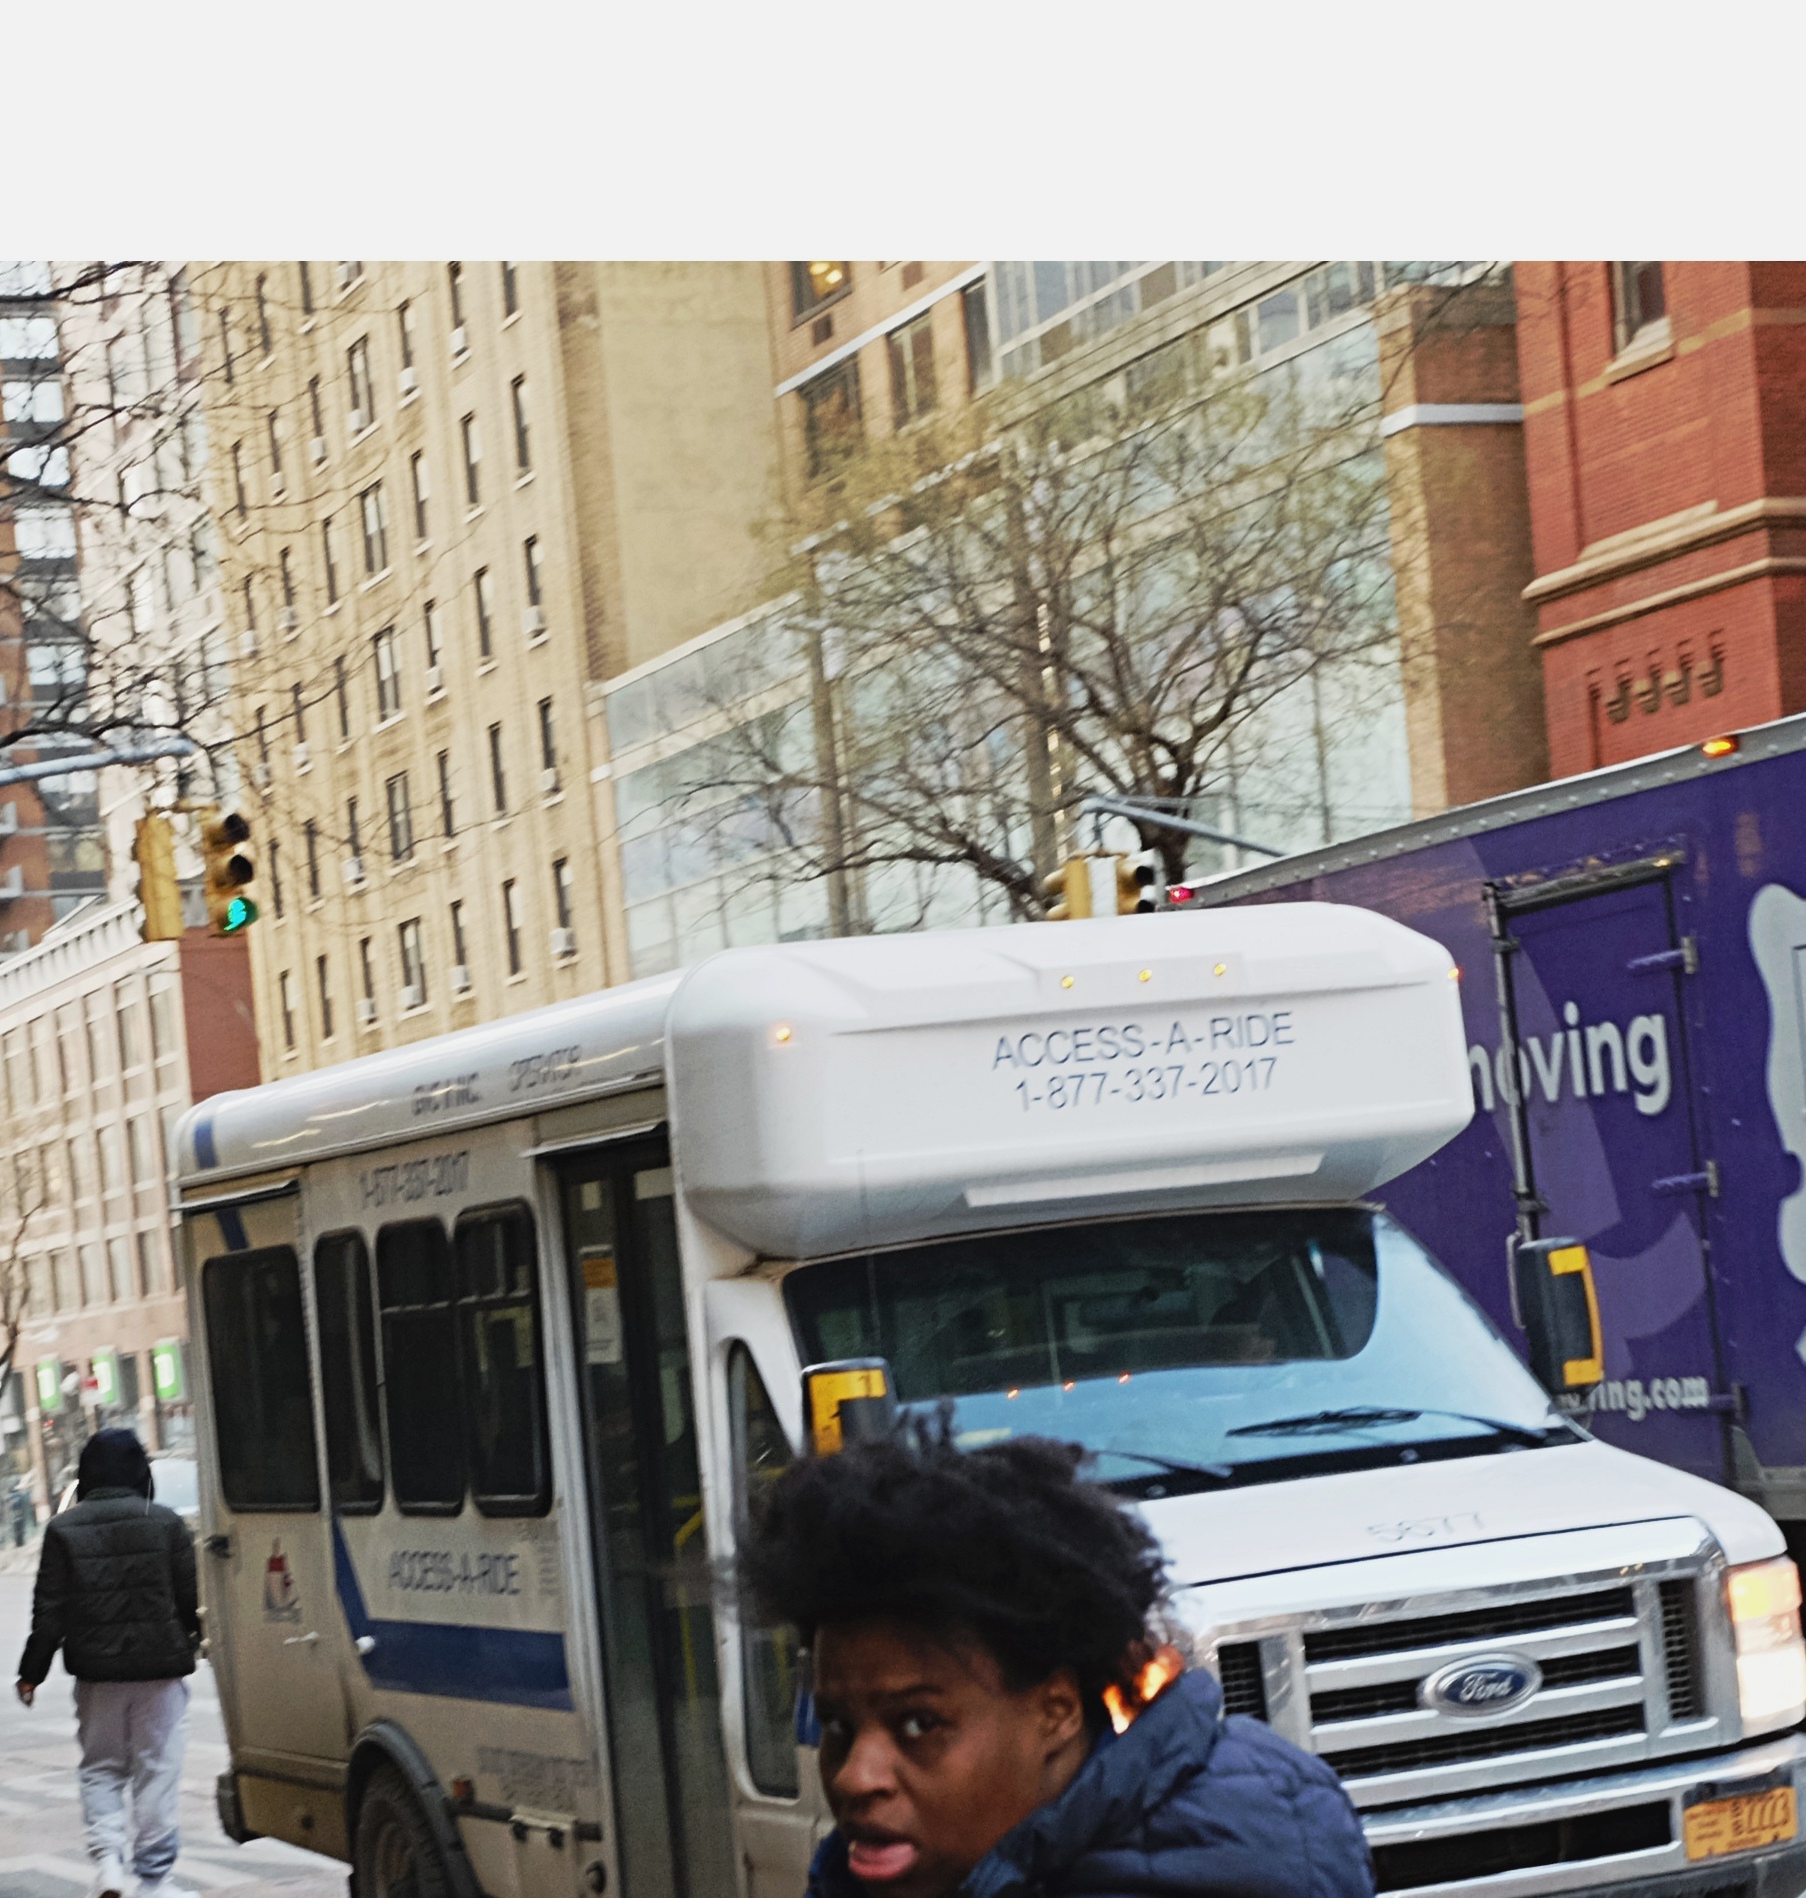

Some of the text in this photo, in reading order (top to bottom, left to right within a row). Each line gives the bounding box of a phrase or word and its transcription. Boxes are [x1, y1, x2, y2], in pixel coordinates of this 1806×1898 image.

[992, 1010, 1296, 1072] ACCESS-A-RIDE
[1015, 1056, 1278, 1113] 1-877-337-2017
[1459, 1673, 1514, 1702] Ford
